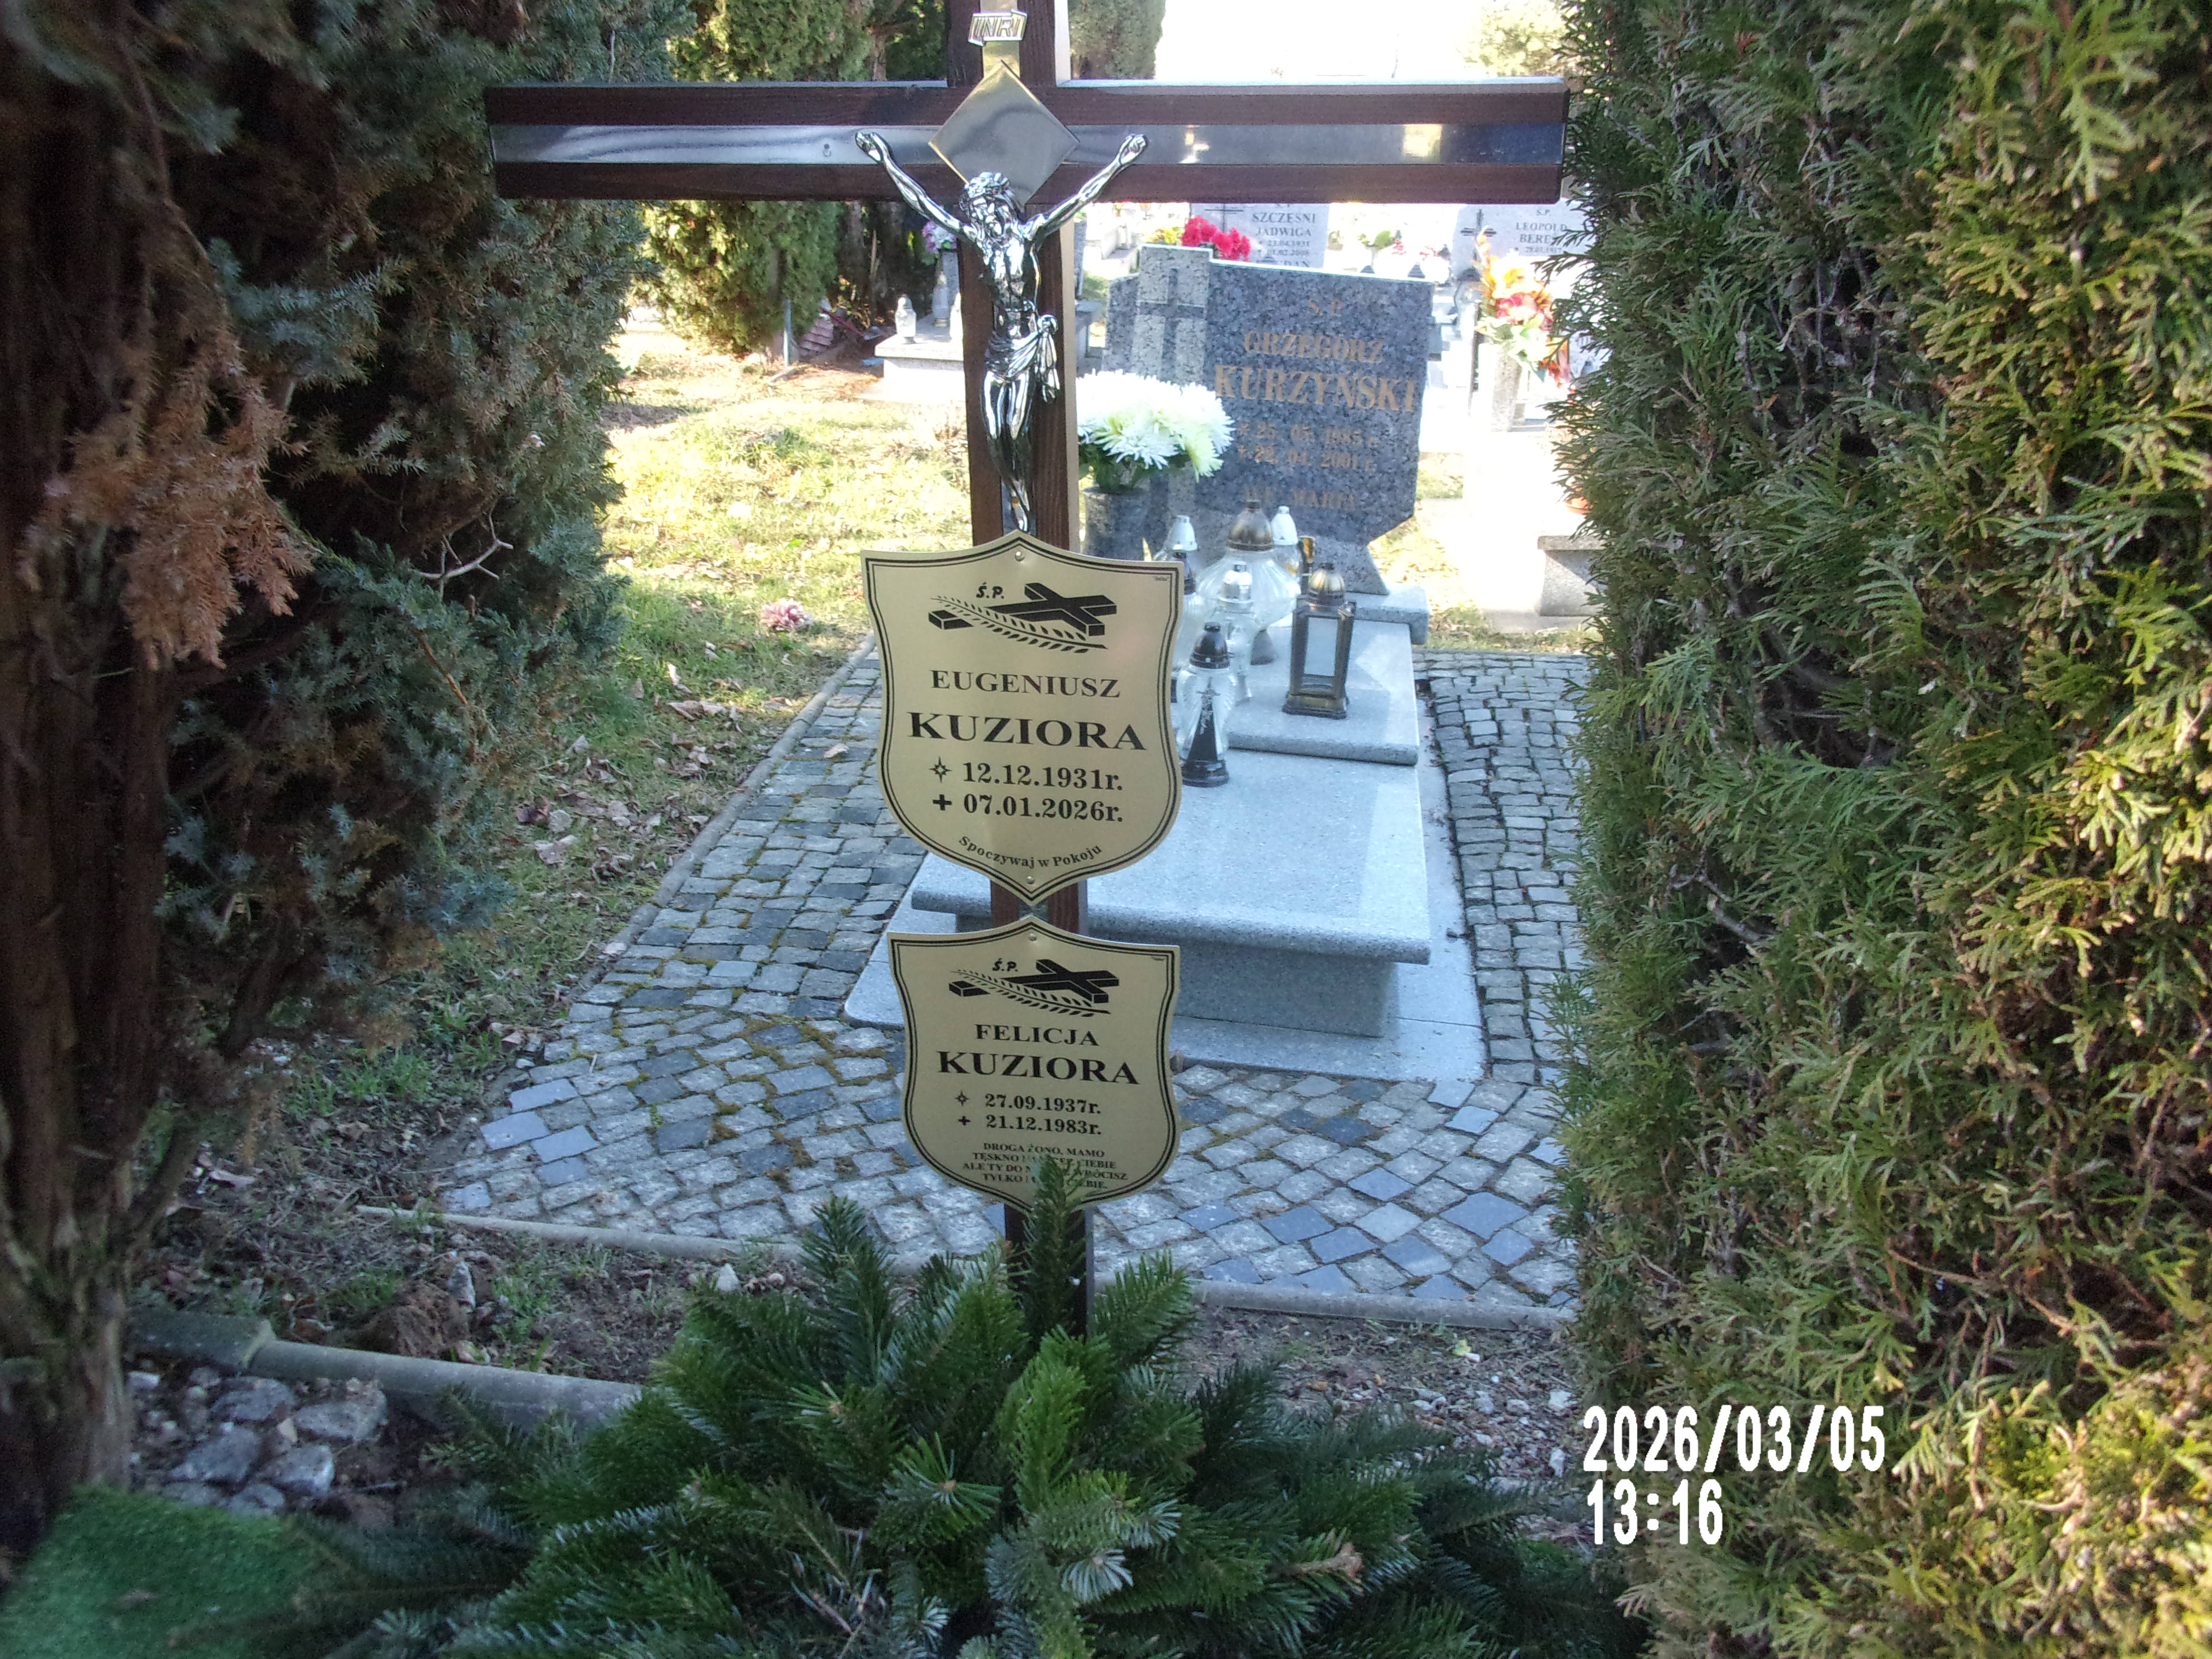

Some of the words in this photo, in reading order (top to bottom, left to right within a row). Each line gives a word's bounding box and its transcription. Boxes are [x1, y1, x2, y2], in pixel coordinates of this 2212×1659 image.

[974, 16, 1022, 37] INRI
[1256, 227, 1311, 237] JADWIGA
[1515, 222, 1567, 231] LEOPOLD
[1244, 331, 1383, 363] GRZEGORZ
[1214, 364, 1415, 412] KURZYŃSKI
[976, 582, 1004, 599] Ś.P.
[930, 670, 1121, 698] EUGENIUSZ
[907, 712, 1147, 750] KUZIORA
[963, 762, 1122, 791] 12.12.1931r.
[963, 793, 1123, 822] 07.01.2026r.
[959, 836, 1034, 869] Spoczywaj
[1038, 859, 1050, 867] w
[1053, 845, 1102, 866] Pokoju
[974, 1024, 1099, 1046] FELICJA
[937, 1051, 1140, 1085] KUZIORA
[985, 1093, 1102, 1114] 27.09.1937r.
[986, 1115, 1102, 1135] 21.12.1983r.
[984, 1142, 1025, 1152] DROGA
[1067, 1148, 1105, 1157] MAMO
[1006, 1164, 1023, 1172] DO
